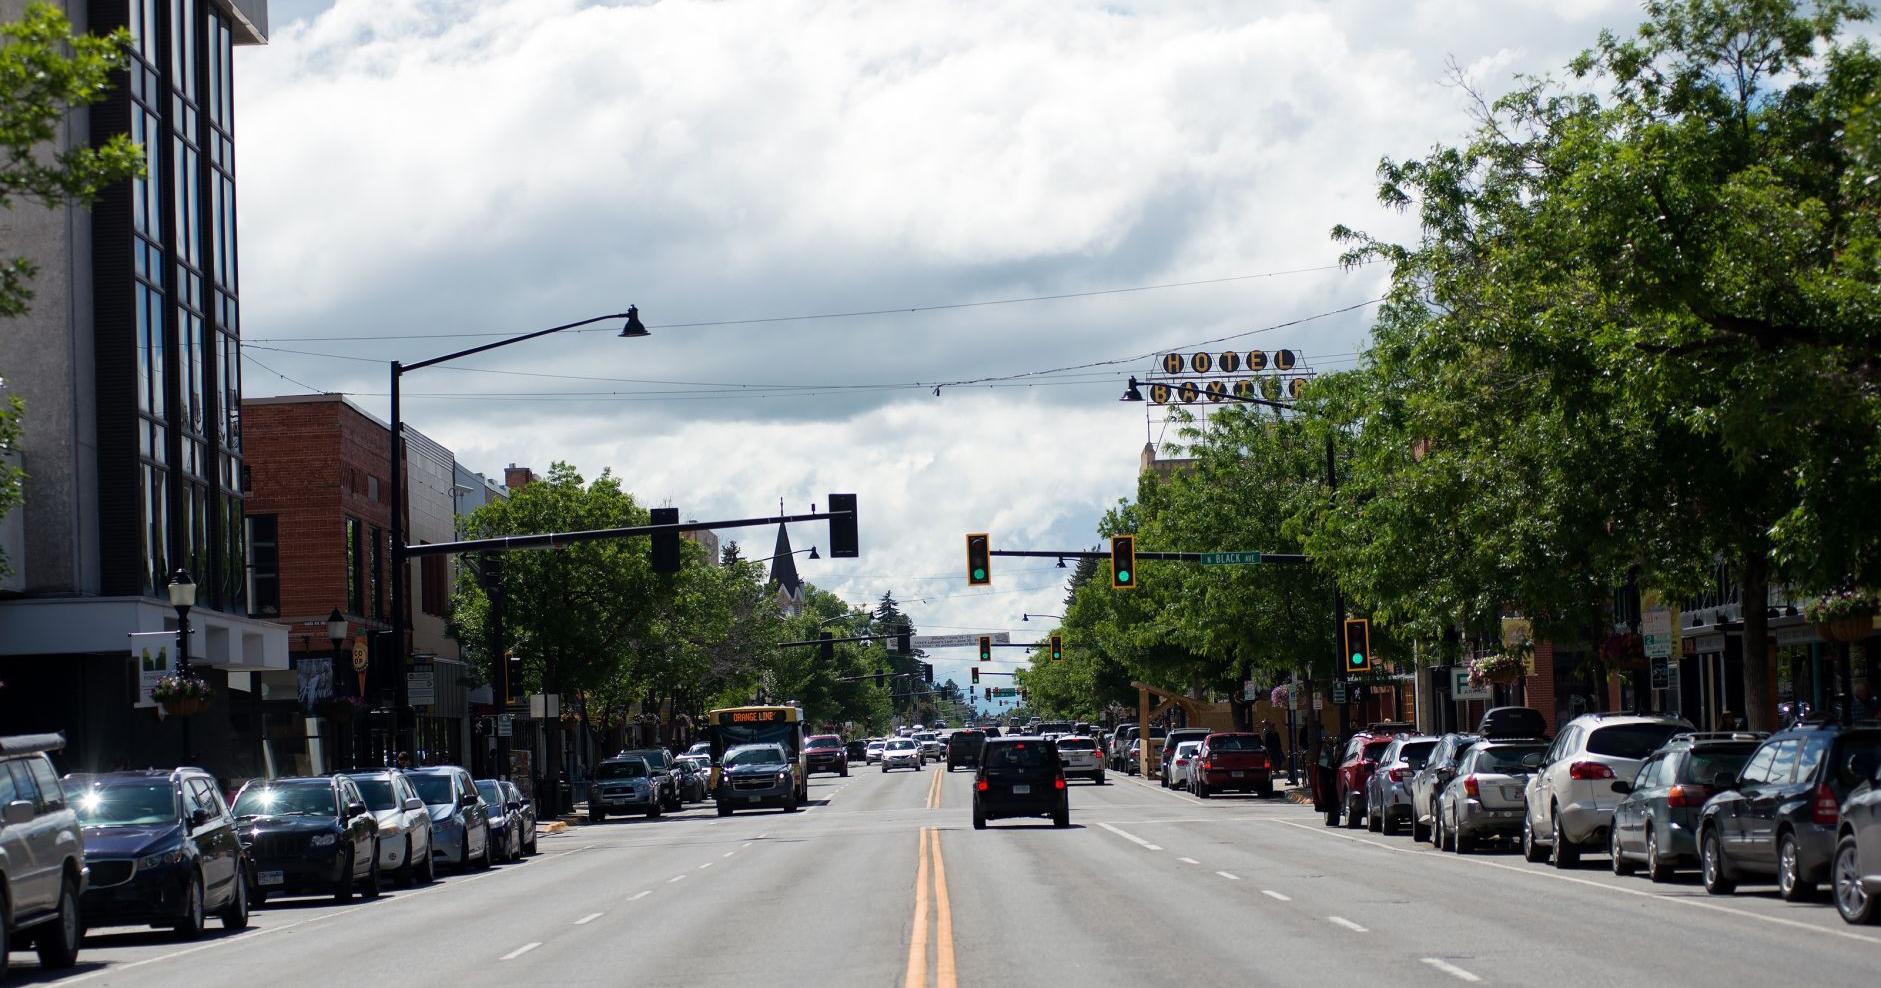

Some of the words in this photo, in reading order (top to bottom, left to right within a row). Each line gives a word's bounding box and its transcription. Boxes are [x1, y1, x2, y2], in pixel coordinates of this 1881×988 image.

[1166, 350, 1293, 374] HOTEL
[1215, 553, 1241, 564] BLACK
[1245, 554, 1256, 563] AVE
[733, 712, 758, 722] ORANGE
[758, 711, 775, 721] LINE
